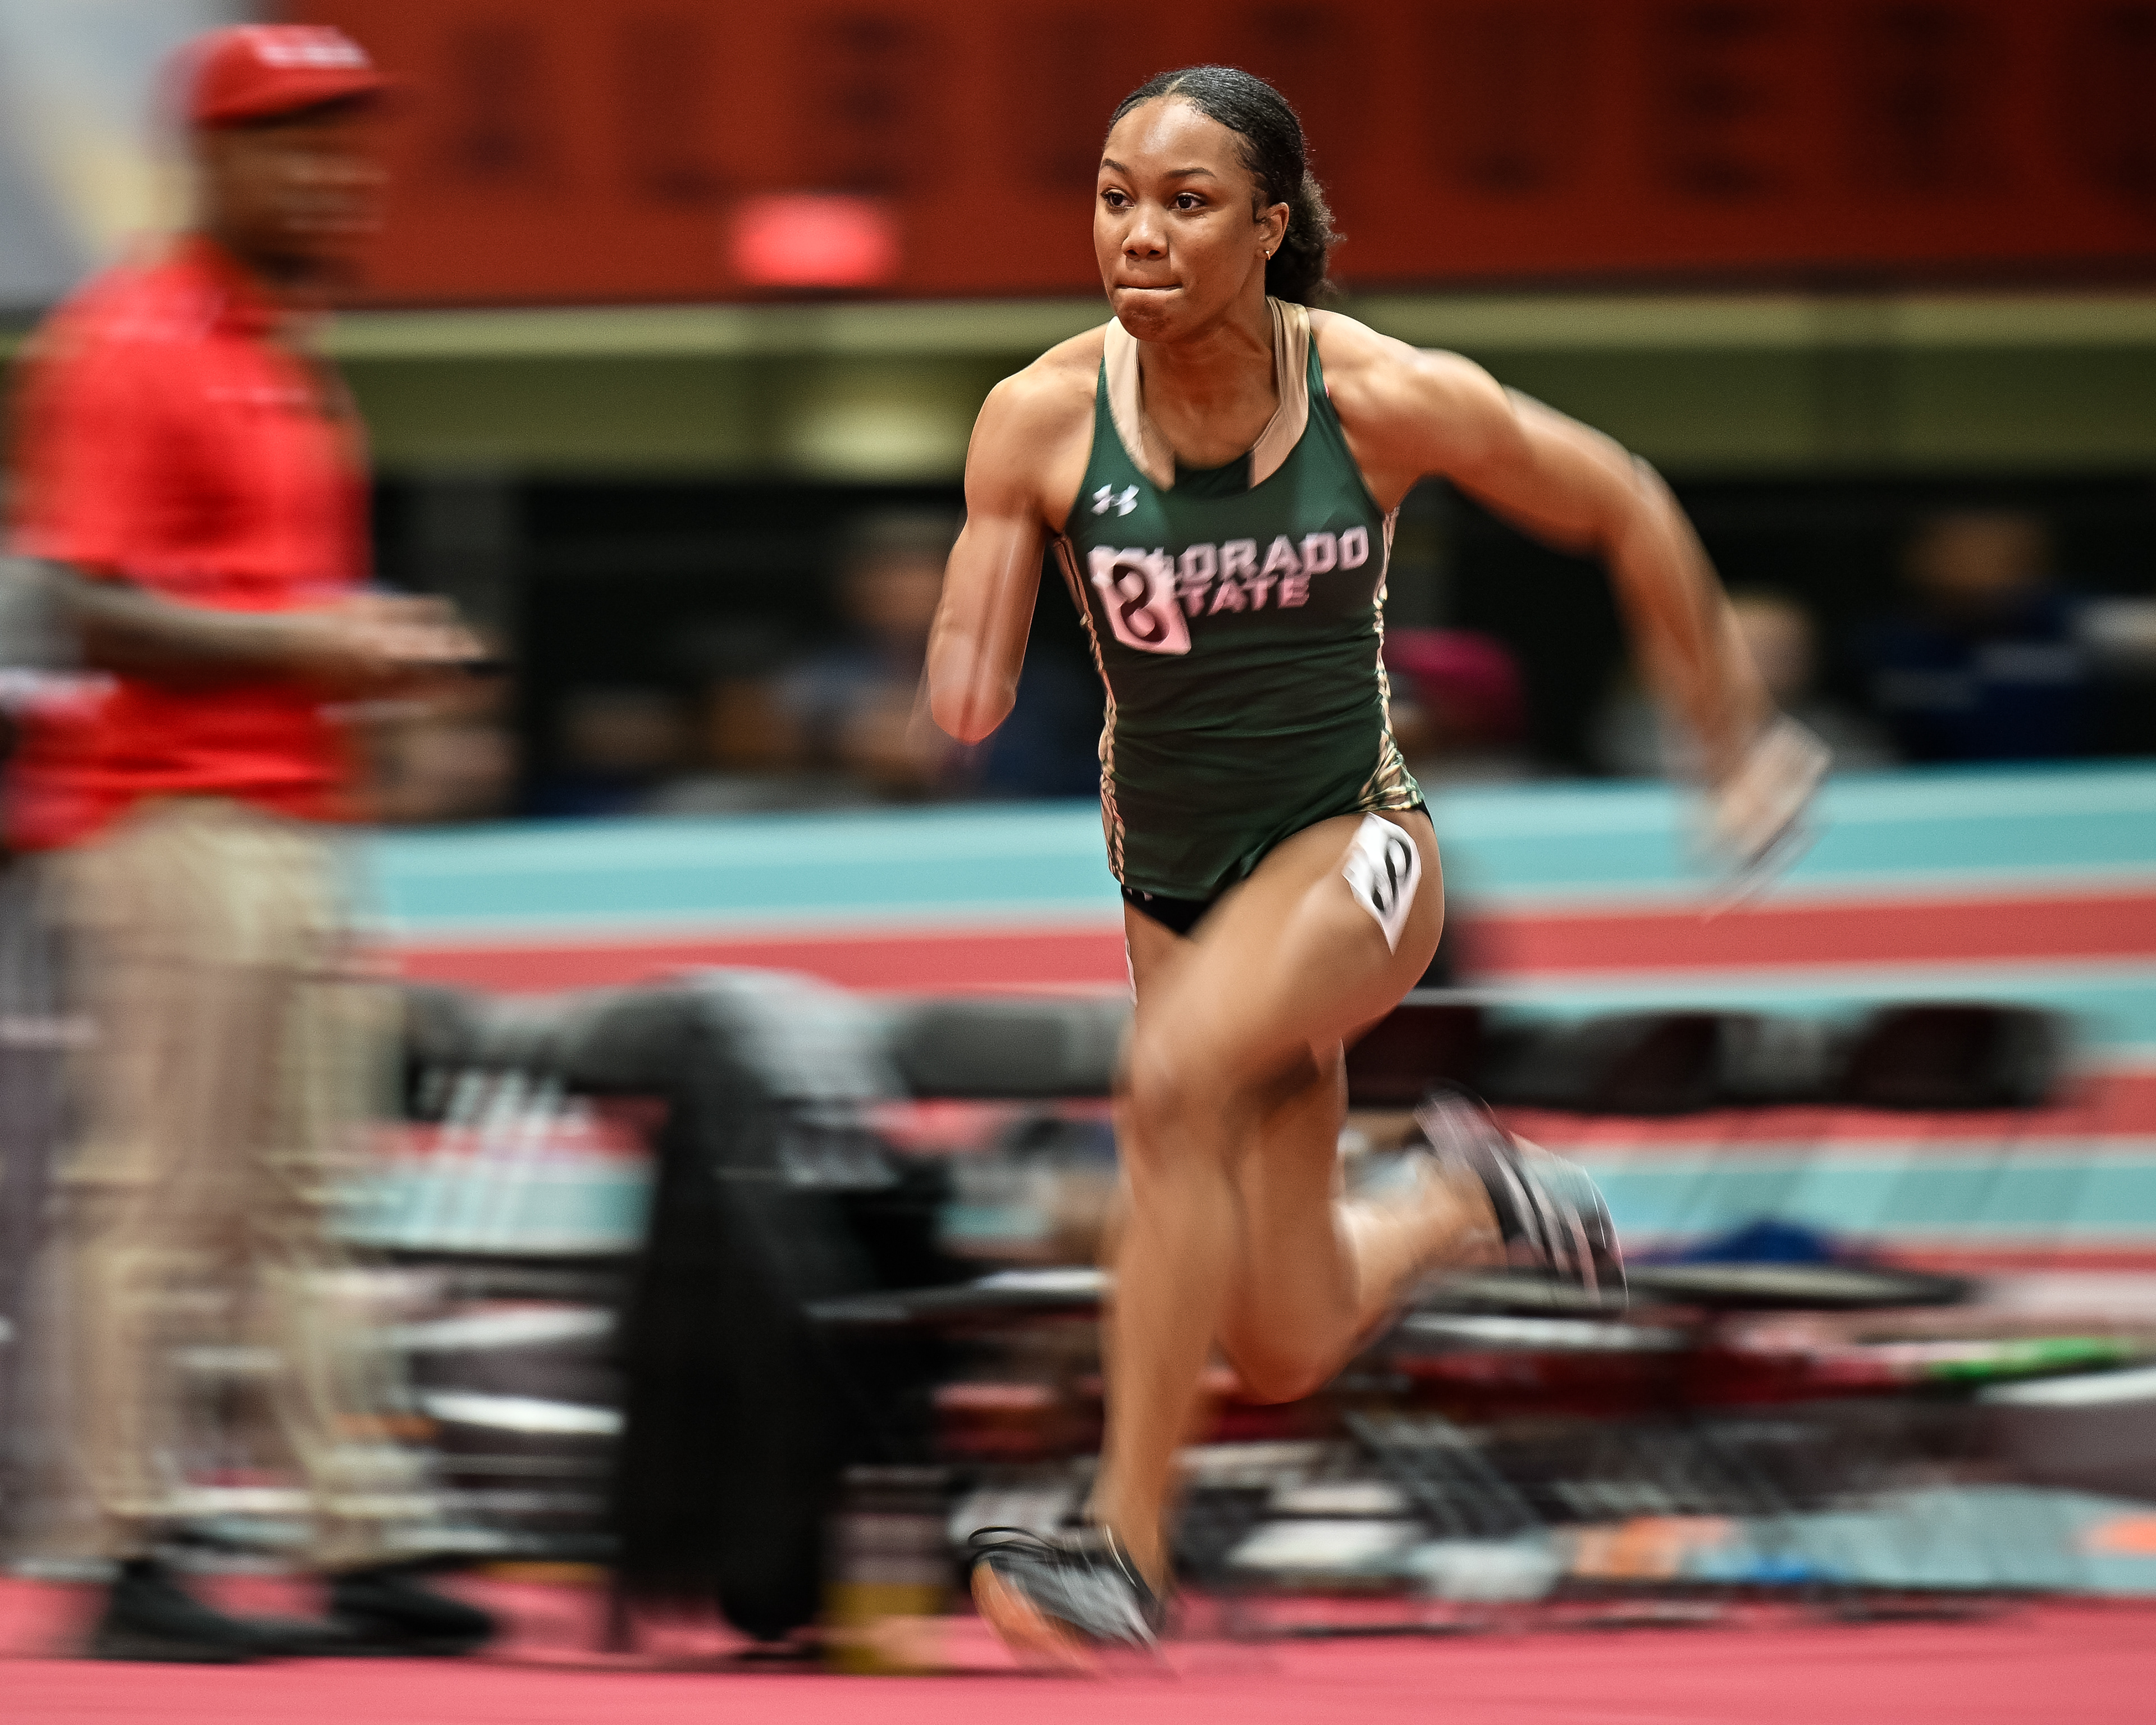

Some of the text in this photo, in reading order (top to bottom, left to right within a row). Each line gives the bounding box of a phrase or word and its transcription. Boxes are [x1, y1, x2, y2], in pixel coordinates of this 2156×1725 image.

[1087, 526, 1370, 586] CORADO
[1112, 562, 1170, 645] 8
[1175, 574, 1311, 618] TATE
